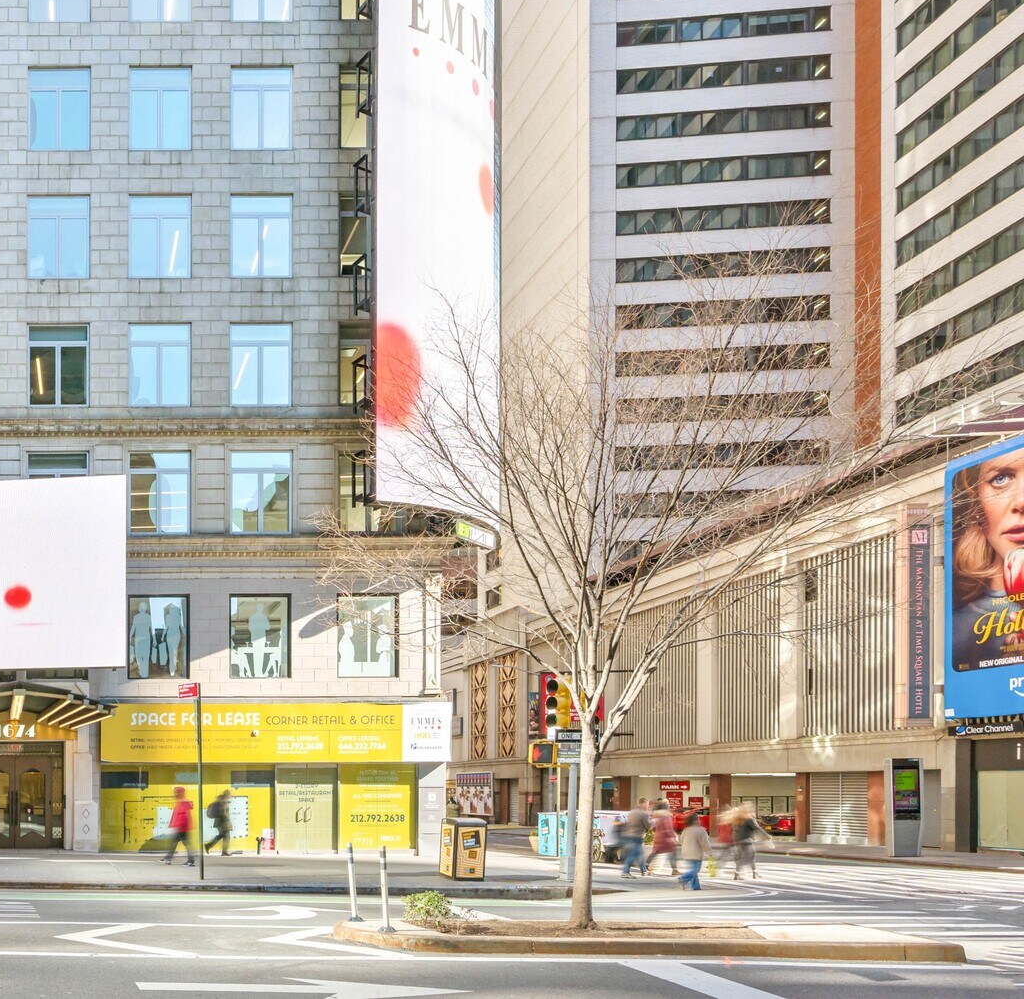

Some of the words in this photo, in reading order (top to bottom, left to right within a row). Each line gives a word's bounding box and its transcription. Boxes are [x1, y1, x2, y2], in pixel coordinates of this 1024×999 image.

[915, 548, 924, 564] THE
[915, 566, 924, 617] MANHATTAN
[915, 618, 923, 629] AT
[915, 630, 924, 654] TIMES
[979, 659, 994, 668] NEW
[994, 655, 1024, 666] ORIGINAL
[914, 655, 924, 687] SQUARE
[915, 688, 923, 715] HOTEL
[130, 712, 176, 726] SPACE
[217, 712, 261, 726] LEASE
[265, 715, 308, 725] CORNER
[312, 715, 346, 725] RETAIL
[349, 715, 357, 725] &
[360, 715, 395, 725] OFFICE
[410, 717, 442, 725] EMMES
[965, 725, 984, 734] Clear
[984, 724, 1014, 733] Channel
[350, 814, 405, 823] 212.792.2638
